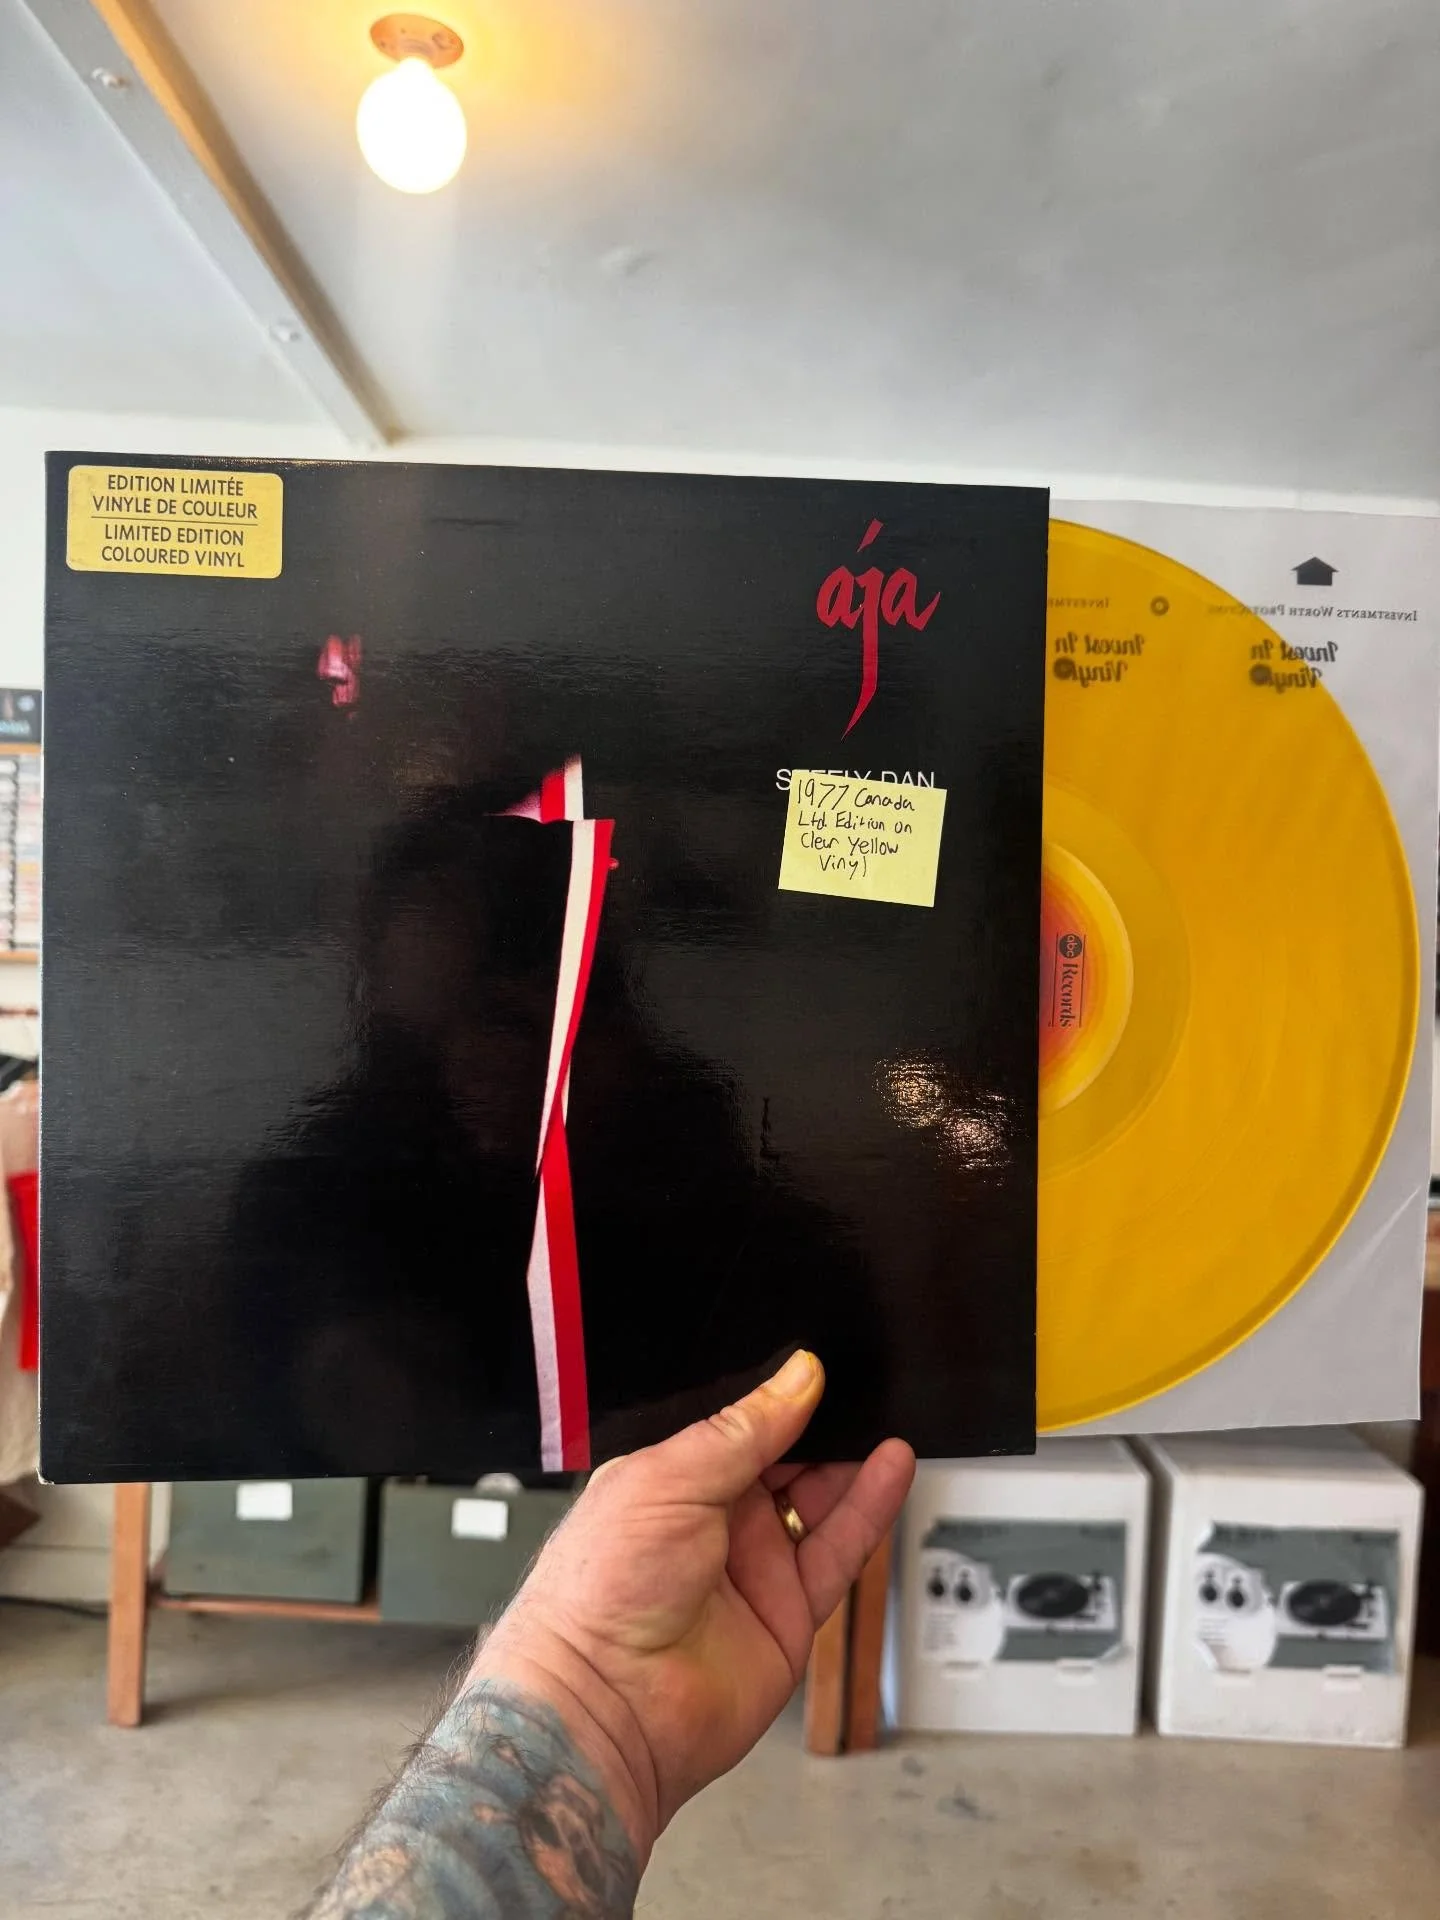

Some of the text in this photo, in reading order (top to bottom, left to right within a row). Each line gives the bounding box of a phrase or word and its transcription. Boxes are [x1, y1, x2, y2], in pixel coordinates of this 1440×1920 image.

[108, 474, 244, 496] EDITION LIMITÉE
[93, 495, 258, 519] VINYLE DE COULEUR
[105, 524, 244, 546] LIMITED EDITION
[101, 546, 245, 567] COLOURED VINYL
[797, 778, 850, 811] 1977
[854, 787, 915, 811] Canada
[798, 810, 827, 830] Ltd.
[836, 811, 885, 831] Edition
[801, 831, 839, 850] Clear
[819, 855, 867, 880] Vinyl
[1059, 963, 1079, 1028] Records
